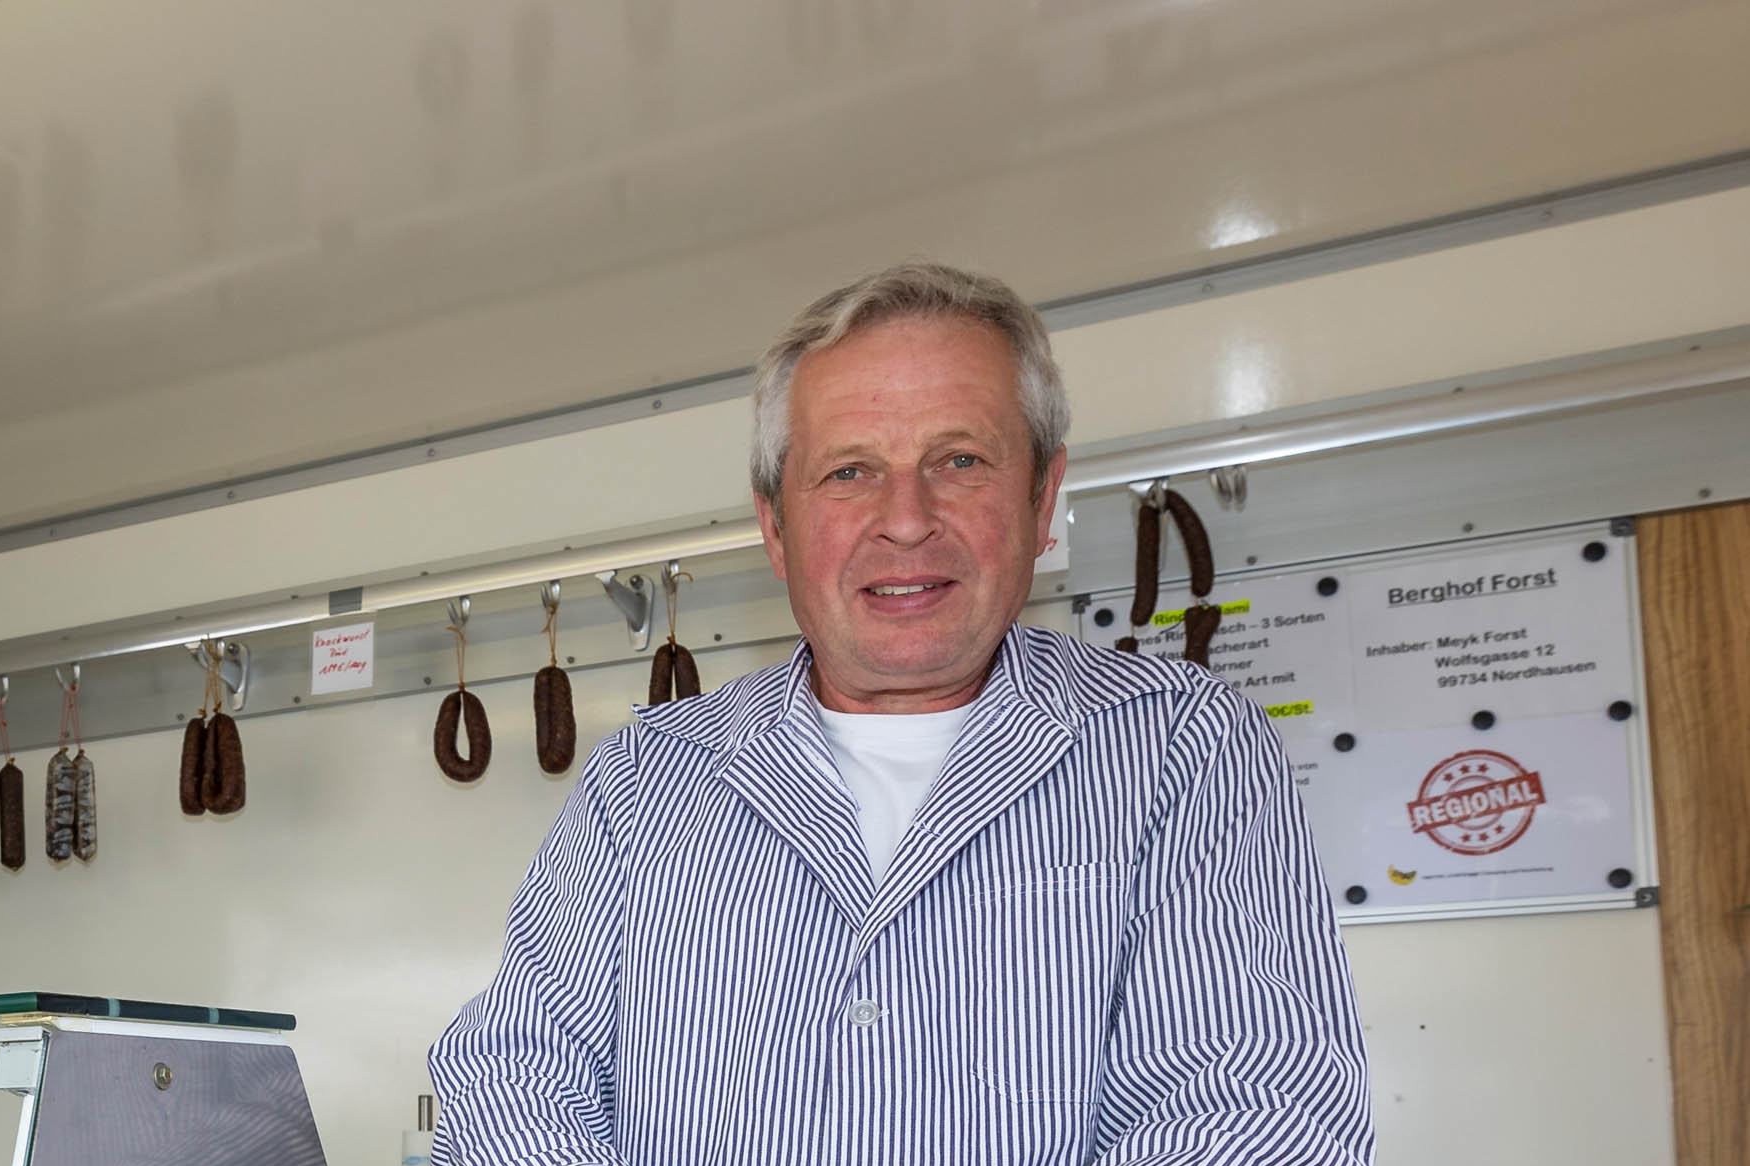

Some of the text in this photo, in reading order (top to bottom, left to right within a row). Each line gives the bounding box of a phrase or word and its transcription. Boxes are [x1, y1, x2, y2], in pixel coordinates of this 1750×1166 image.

[1388, 568, 1556, 604] Berghof Forst
[1260, 616, 1271, 629] 3
[1274, 611, 1325, 628] Sorten
[1366, 639, 1431, 657] Inhaber:
[1483, 628, 1527, 644] Forst
[1435, 644, 1555, 668] Wolfsgasse 12
[1437, 660, 1596, 688] 99734 Nordhausen
[1413, 781, 1538, 826] REGIONAL
